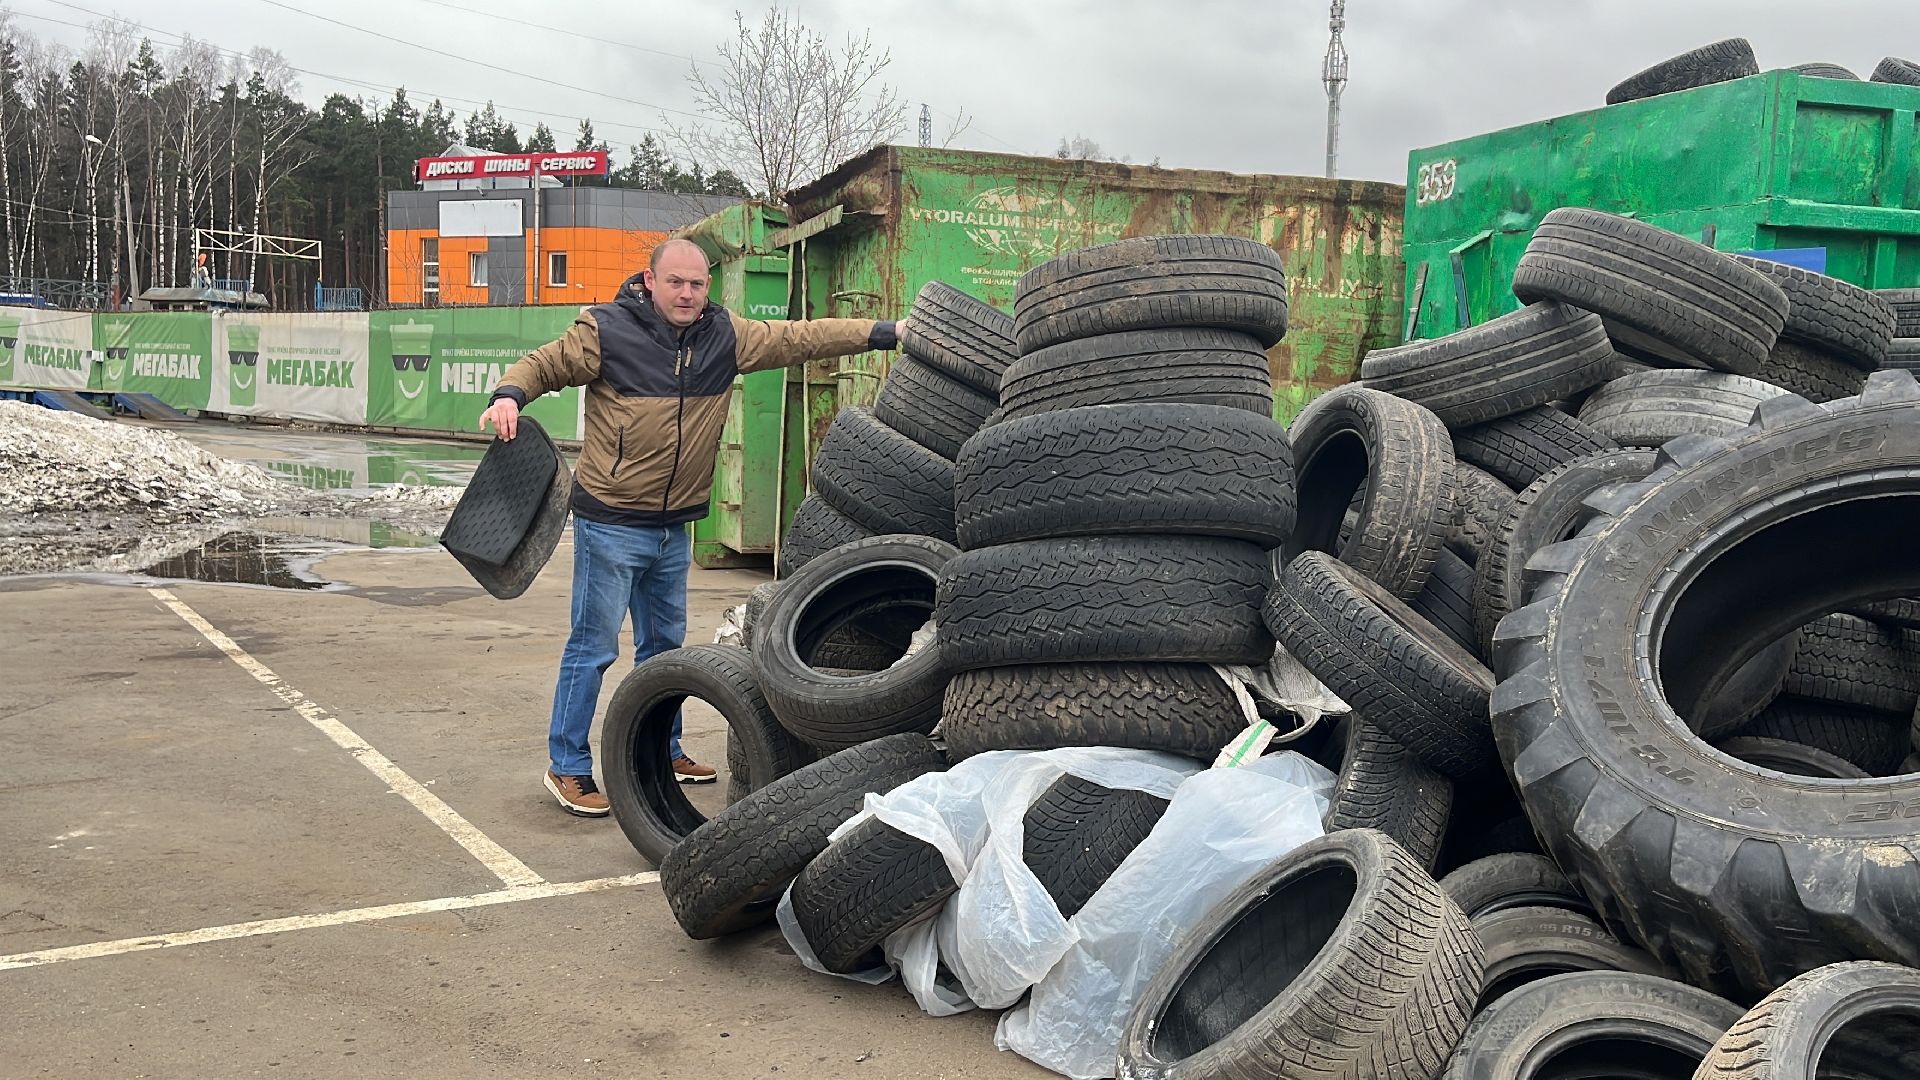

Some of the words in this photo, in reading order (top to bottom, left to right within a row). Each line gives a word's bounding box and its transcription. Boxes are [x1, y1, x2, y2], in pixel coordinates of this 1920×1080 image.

[426, 160, 474, 176] ДИСКИ
[484, 158, 531, 173] ШИНЫ
[541, 156, 596, 171] СЕРВИС
[750, 304, 788, 316] VTOR
[24, 344, 83, 370] МЕГАБАК
[132, 353, 201, 379] МЕГАБАК
[267, 358, 354, 388] МЕГАБАК
